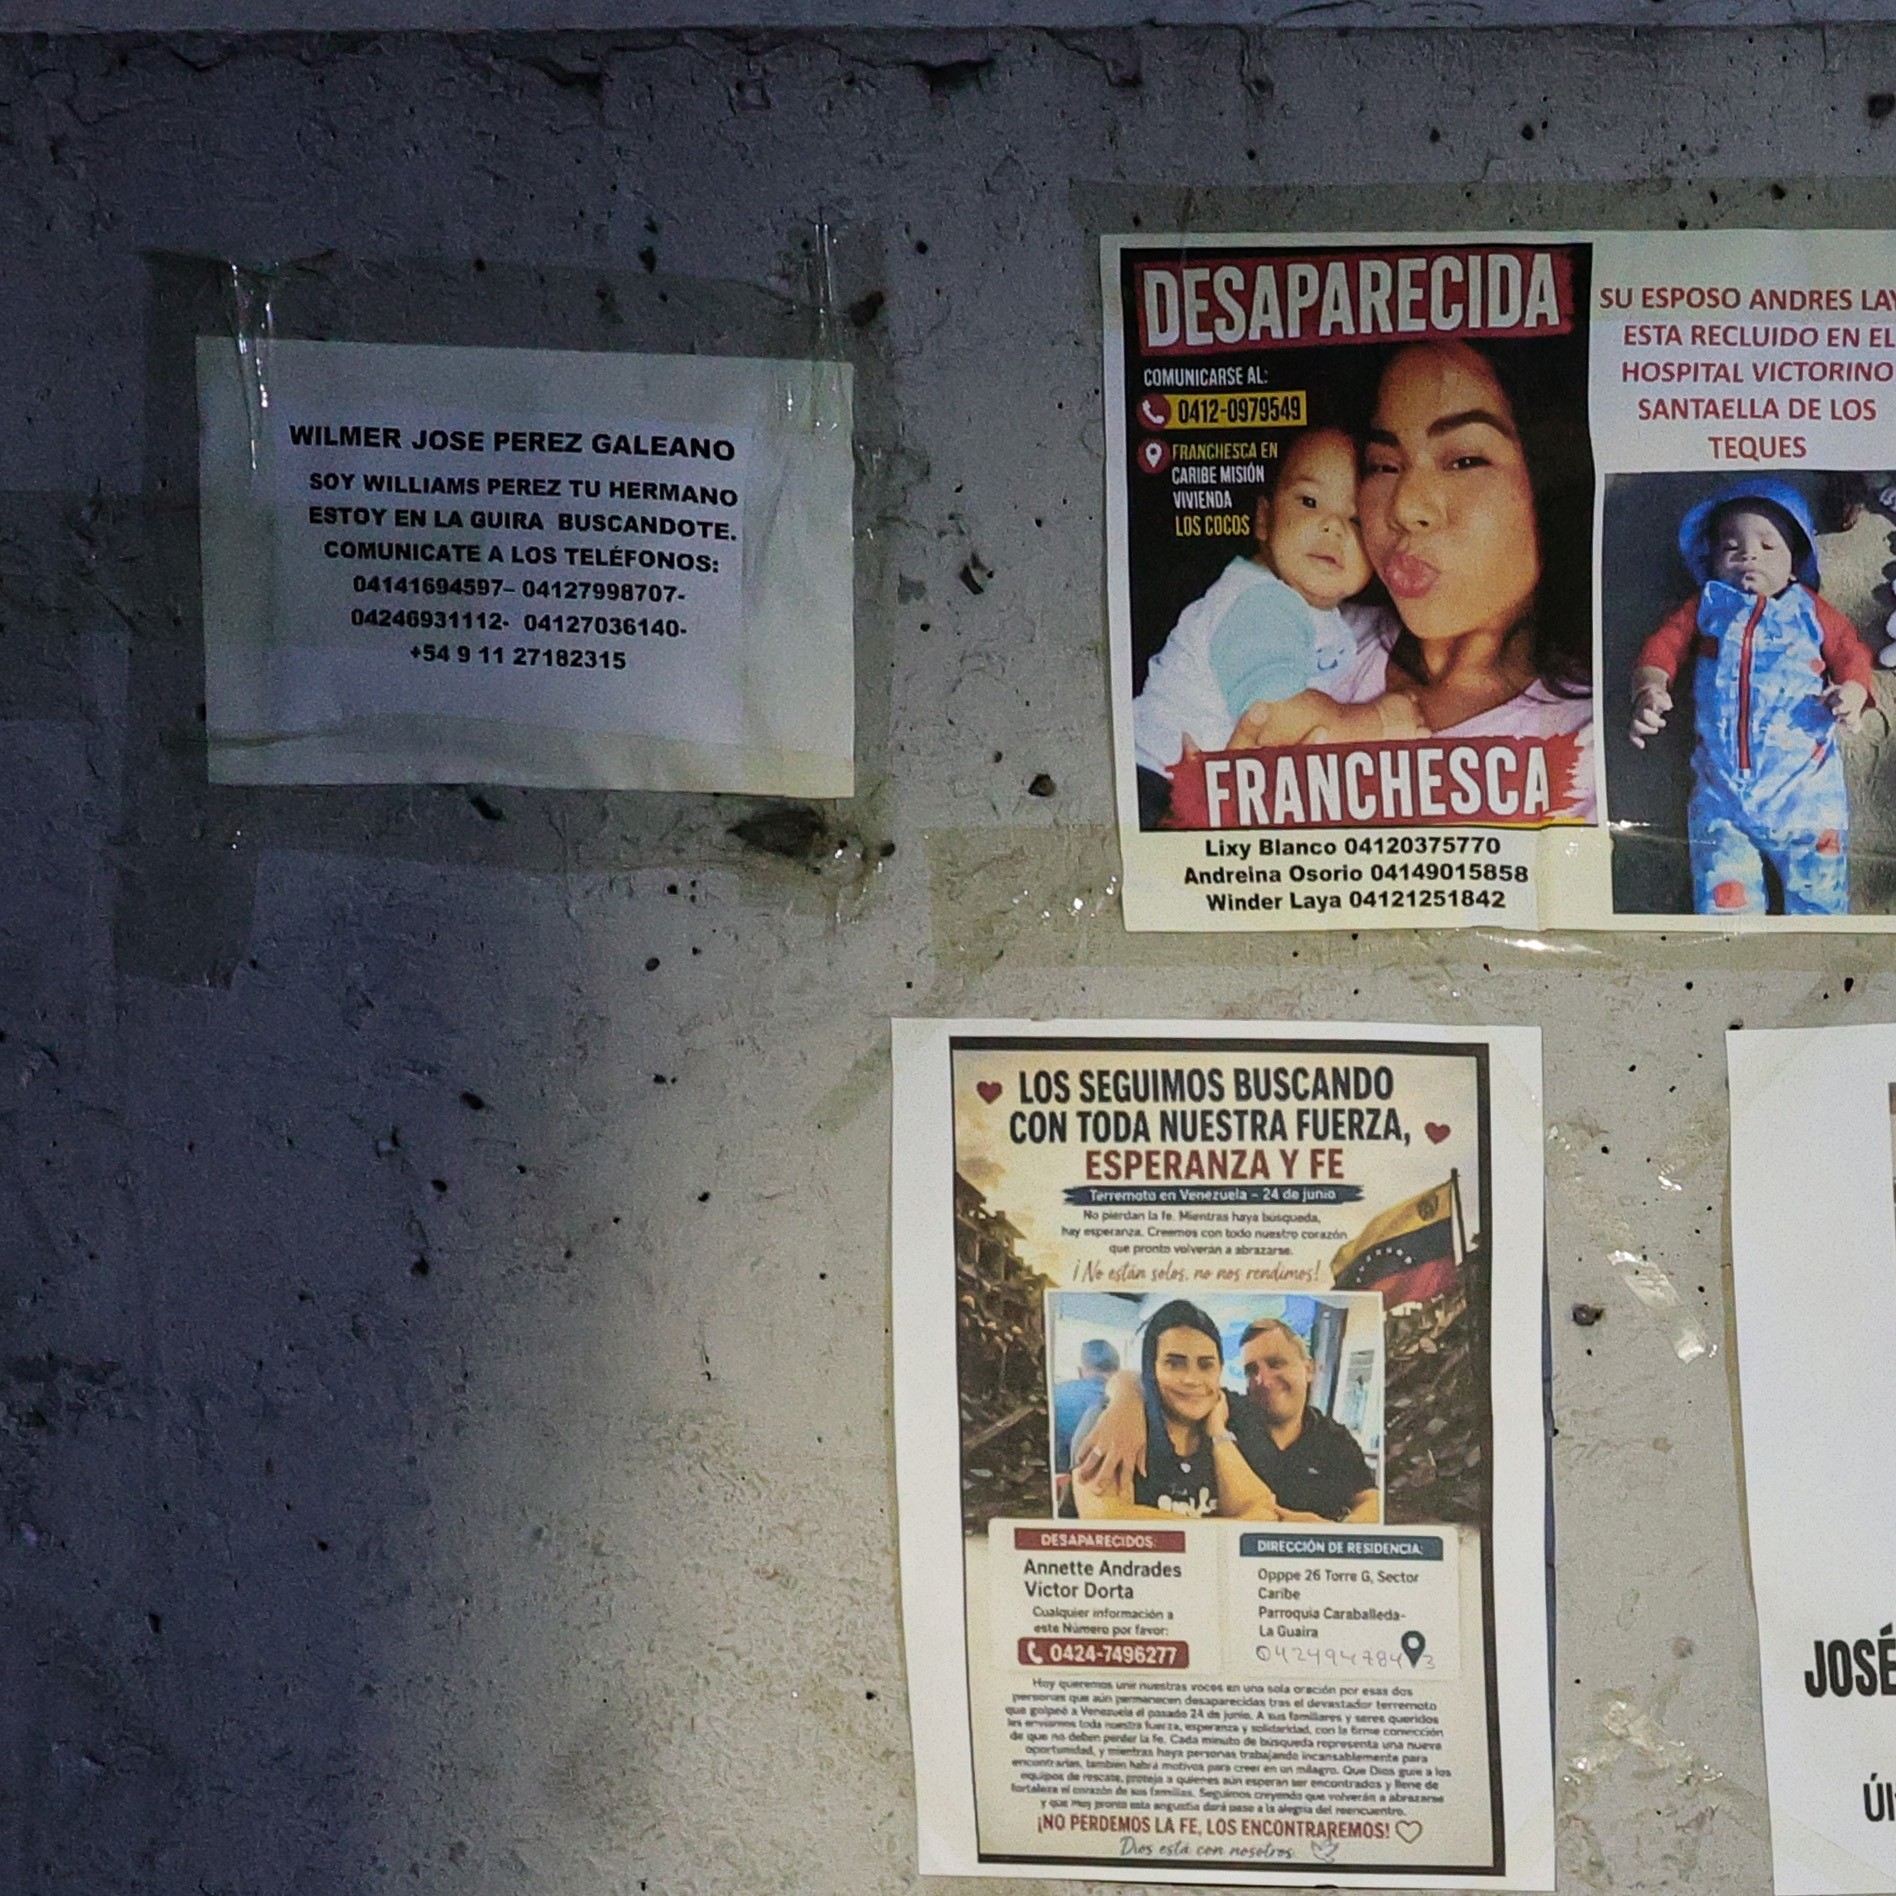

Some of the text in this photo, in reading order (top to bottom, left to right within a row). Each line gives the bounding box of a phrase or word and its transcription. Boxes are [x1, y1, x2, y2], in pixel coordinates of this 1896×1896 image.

[1143, 252, 1560, 347] DESAPARECIDA
[1599, 287, 1632, 309] SU
[1641, 286, 1741, 309] ESPOSO
[1748, 288, 1852, 311] ANDRES
[1623, 324, 1895, 348] ESTA RECLUIDO EN EL
[1621, 361, 1893, 383] HOSPITAL VICTORINO
[1178, 395, 1302, 424] 0412-0979549
[1637, 397, 1876, 421] SANTAELLA DE LOS
[288, 424, 735, 461] WILMER JOSE PEREZ GALEANO
[1707, 435, 1807, 462] TEQUES
[309, 471, 738, 507] SOY WILLIAMS PEREZ TU HERMANO
[1172, 489, 1232, 509] VIVIENDA
[308, 505, 387, 526] ESTOY
[394, 508, 426, 527] EN
[433, 509, 463, 528] LA
[469, 510, 544, 530] GUIRA
[1174, 513, 1250, 537] LOS COCOS
[323, 540, 481, 562] COMUNICATE
[487, 544, 504, 563] A
[510, 545, 557, 564] LOS
[409, 643, 626, 670] +54 9 11 27182315
[1204, 748, 1550, 827] FRANCHESCA
[1205, 835, 1501, 861] Lixy Blanco 04120375770
[1183, 862, 1528, 885] Andreina Osorio 04149015858
[1205, 889, 1506, 913] Winder Laya 04121251842
[1018, 1065, 1393, 1104] LOS SEGUIMOS BUSCANDO
[1009, 1110, 1067, 1144] CON
[1075, 1109, 1151, 1143] TODA
[1159, 1108, 1288, 1142] NUESTRA
[1085, 1147, 1344, 1180] ESPERANZA Y FE
[1023, 1557, 1182, 1578] Annette Andrades
[1258, 1623, 1319, 1638] La Guaira
[1049, 1642, 1177, 1665] 0424-7496277
